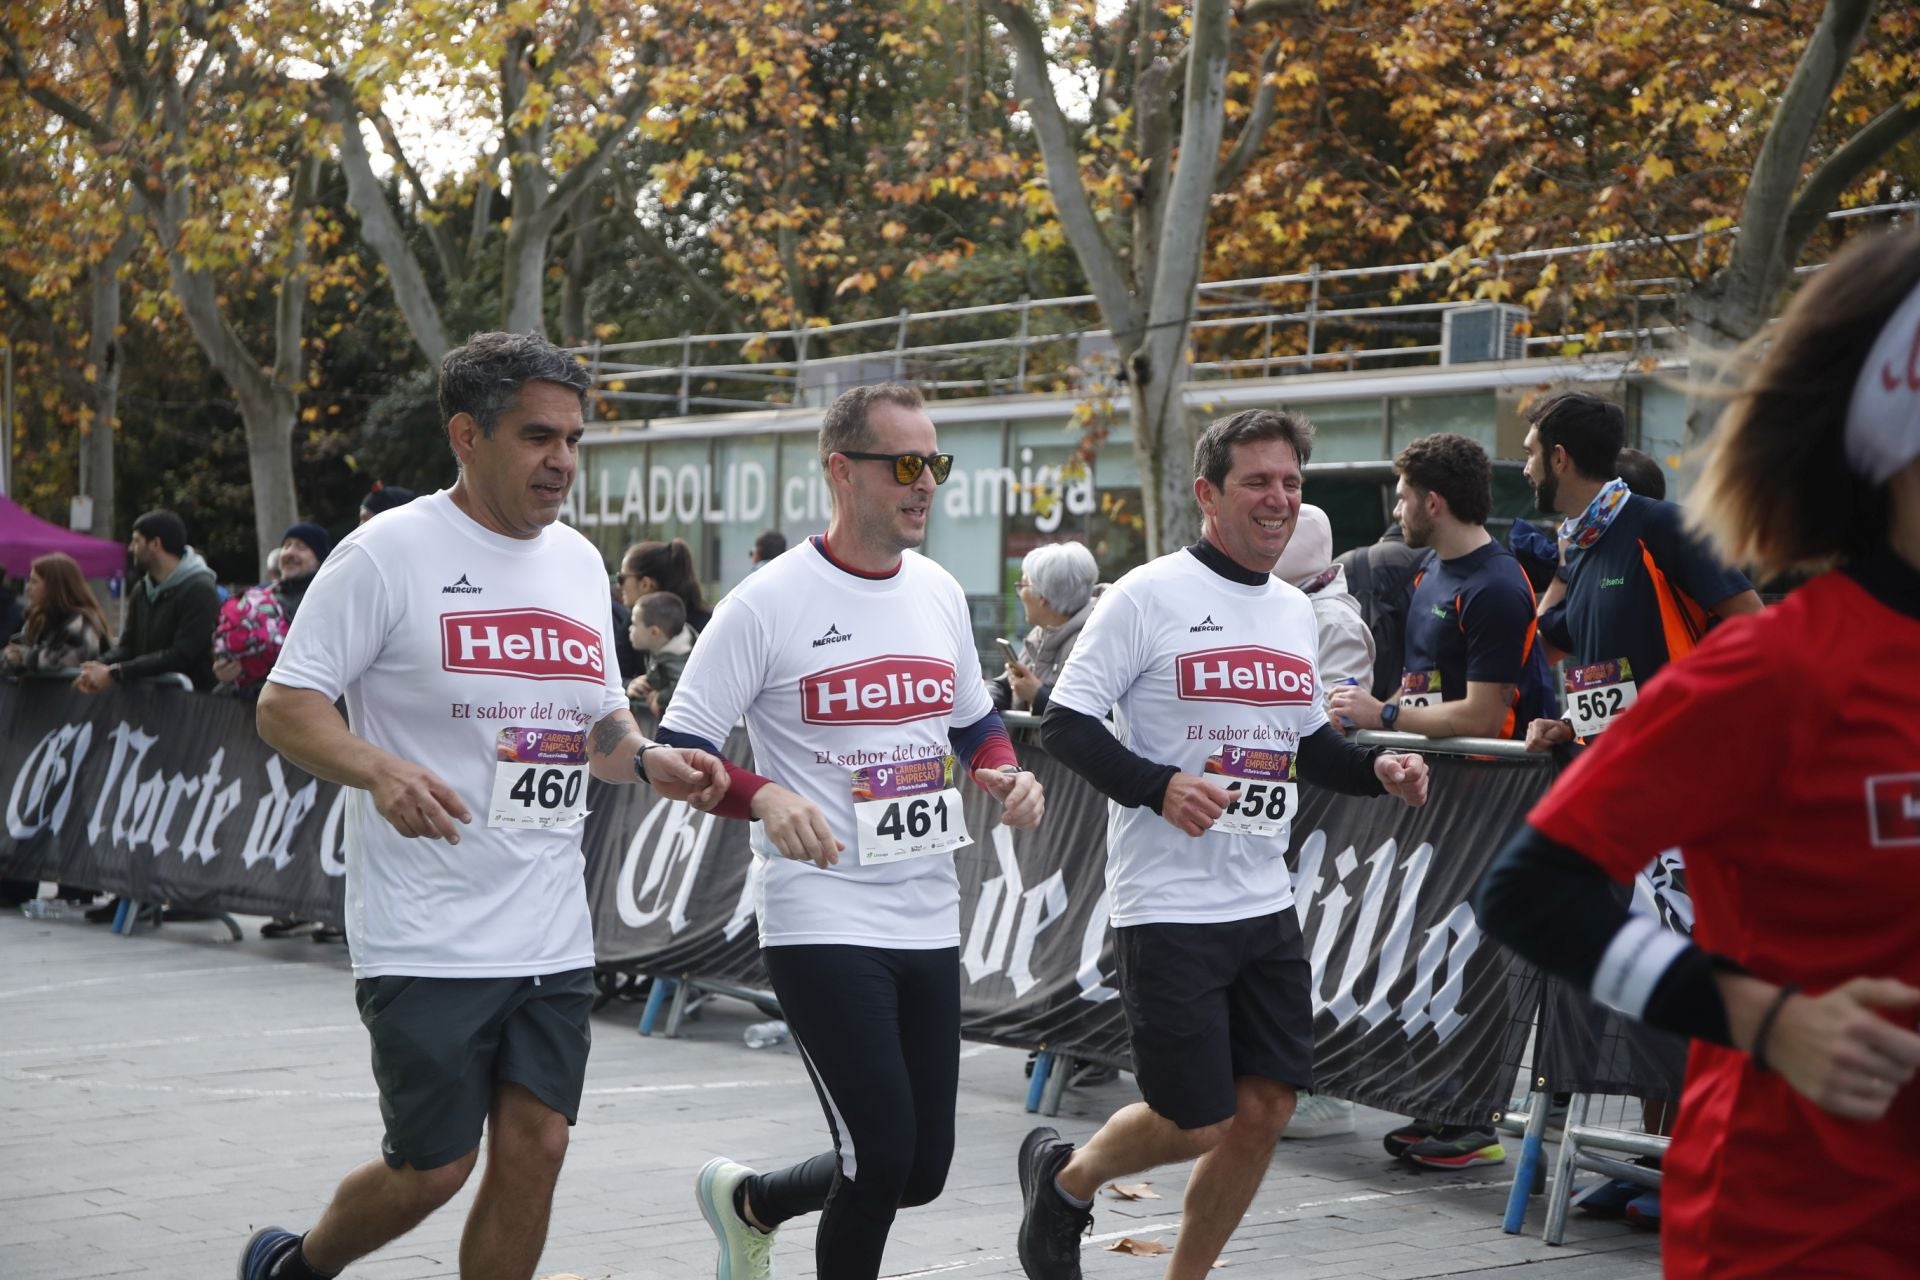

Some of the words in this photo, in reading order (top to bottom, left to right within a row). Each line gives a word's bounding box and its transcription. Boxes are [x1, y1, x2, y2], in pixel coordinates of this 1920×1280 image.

[558, 462, 767, 526] ALLADOLID
[944, 448, 1096, 532] amiga
[442, 586, 483, 594] MERCURY
[812, 633, 852, 648] MERCURY
[1190, 625, 1224, 633] MERCURY
[458, 625, 603, 672] Helios
[1192, 660, 1313, 696] Helios
[816, 673, 954, 714] Helios
[1577, 688, 1626, 722] 562
[451, 703, 470, 718] El
[477, 702, 526, 719] sabor
[530, 702, 553, 720] del
[1187, 725, 1203, 740] El
[1208, 725, 1249, 741] sabor
[1253, 724, 1270, 740] del
[814, 751, 832, 764] El
[837, 750, 887, 767] sabor
[892, 744, 914, 762] del
[894, 762, 926, 774] CARRERA
[1244, 759, 1279, 771] EMPRESAS
[510, 768, 583, 809] 460
[895, 770, 935, 785] EMPRESAS
[6, 720, 93, 841] El
[240, 752, 318, 873] de
[876, 795, 948, 841] 461
[960, 822, 1069, 999] de
